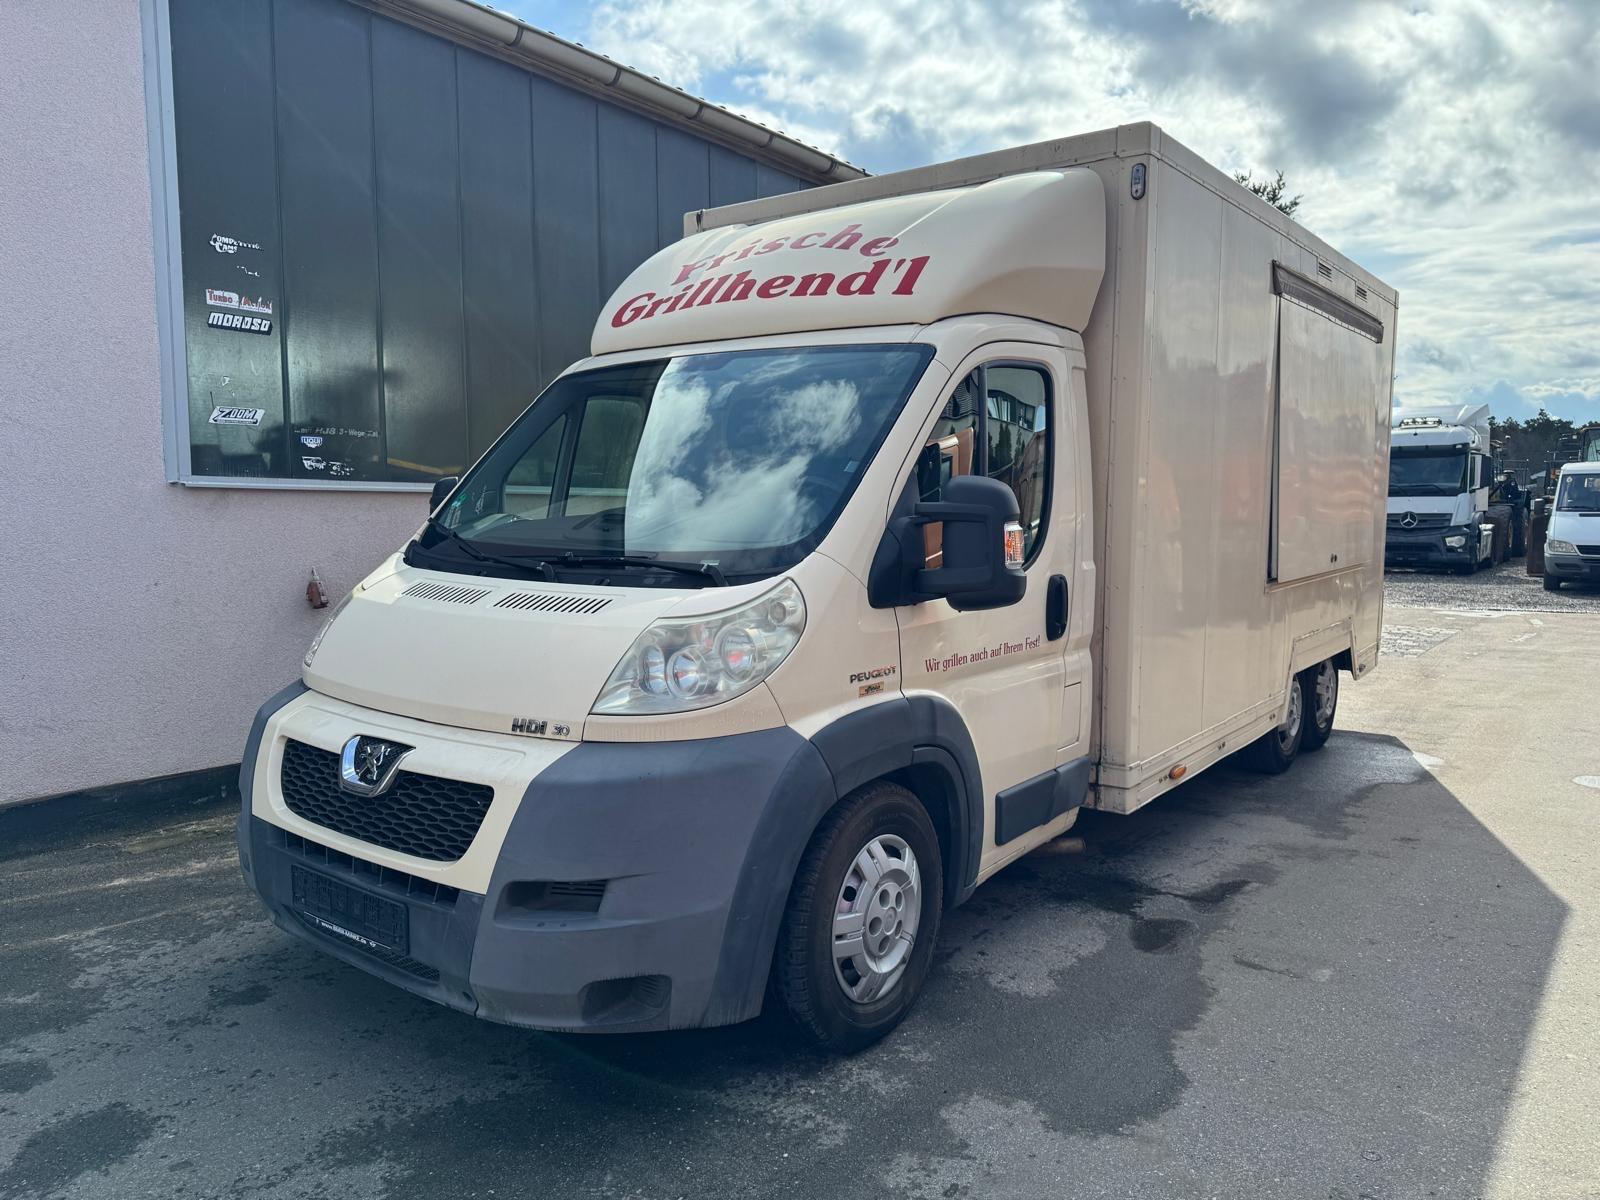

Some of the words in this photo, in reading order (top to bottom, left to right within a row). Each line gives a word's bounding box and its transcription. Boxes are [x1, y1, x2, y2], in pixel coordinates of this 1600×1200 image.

[671, 223, 899, 286] Frische
[611, 256, 930, 328] Grillhend'l
[208, 312, 271, 331] MOROSO
[214, 406, 258, 420] ZOOM
[925, 658, 941, 672] Wir
[942, 652, 968, 672] grillen
[969, 647, 988, 662] auch
[990, 643, 1003, 658] auf
[1003, 642, 1024, 655] Ihrem
[1025, 635, 1041, 650] Fest!
[850, 665, 896, 683] PEUGEOT
